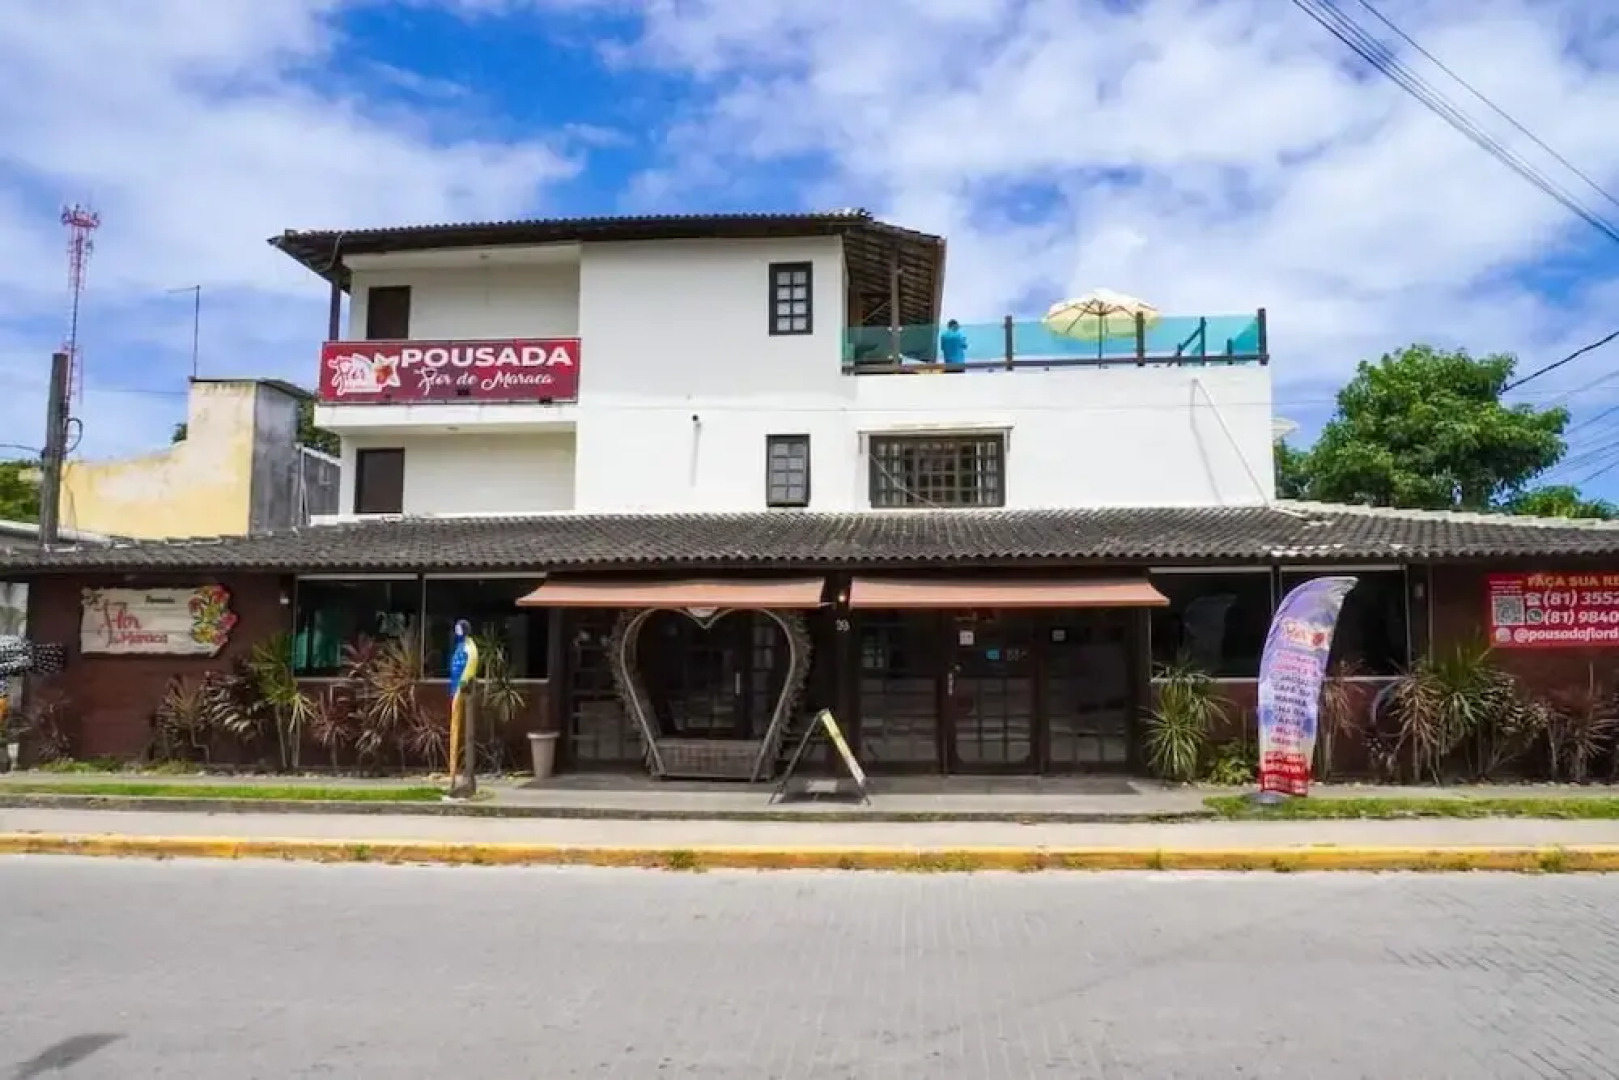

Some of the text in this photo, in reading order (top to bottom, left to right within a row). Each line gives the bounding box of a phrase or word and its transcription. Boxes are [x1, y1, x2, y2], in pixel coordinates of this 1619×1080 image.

[401, 346, 574, 368] POUSADA
[456, 370, 478, 386] de
[1568, 576, 1600, 587] SUA
[1543, 589, 1578, 608] (81)
[1544, 608, 1575, 625] (81)
